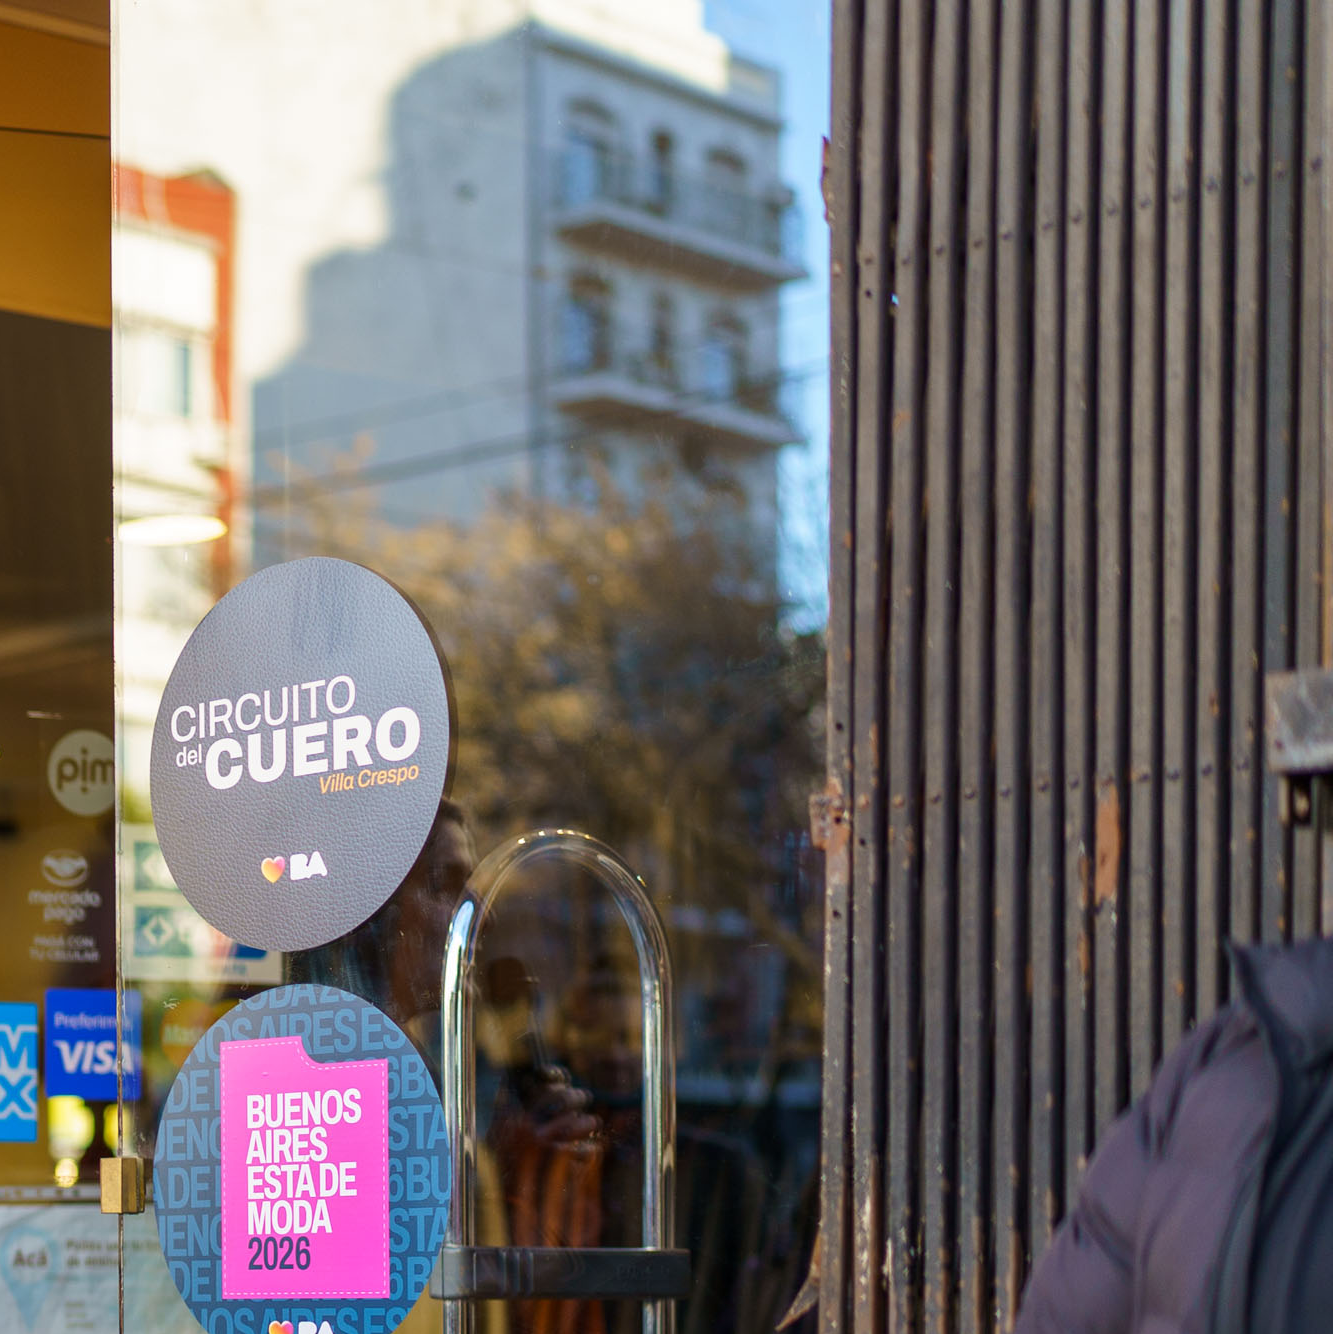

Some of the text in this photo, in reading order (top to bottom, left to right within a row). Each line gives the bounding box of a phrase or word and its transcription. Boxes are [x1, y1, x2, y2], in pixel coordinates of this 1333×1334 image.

[170, 675, 356, 742] CIRCUITO
[175, 706, 421, 789] del CUERO
[319, 765, 420, 795] Villa Crespo
[289, 850, 328, 881] BA
[27, 889, 102, 908] mercado
[43, 905, 86, 926] pago
[54, 1039, 134, 1074] VISA
[246, 1088, 362, 1128] BUENOS
[246, 1126, 328, 1164] AIRES
[319, 1161, 358, 1197] DE
[247, 1199, 332, 1235] MODA
[13, 1247, 48, 1267] Acá
[248, 1236, 311, 1271] 2026
